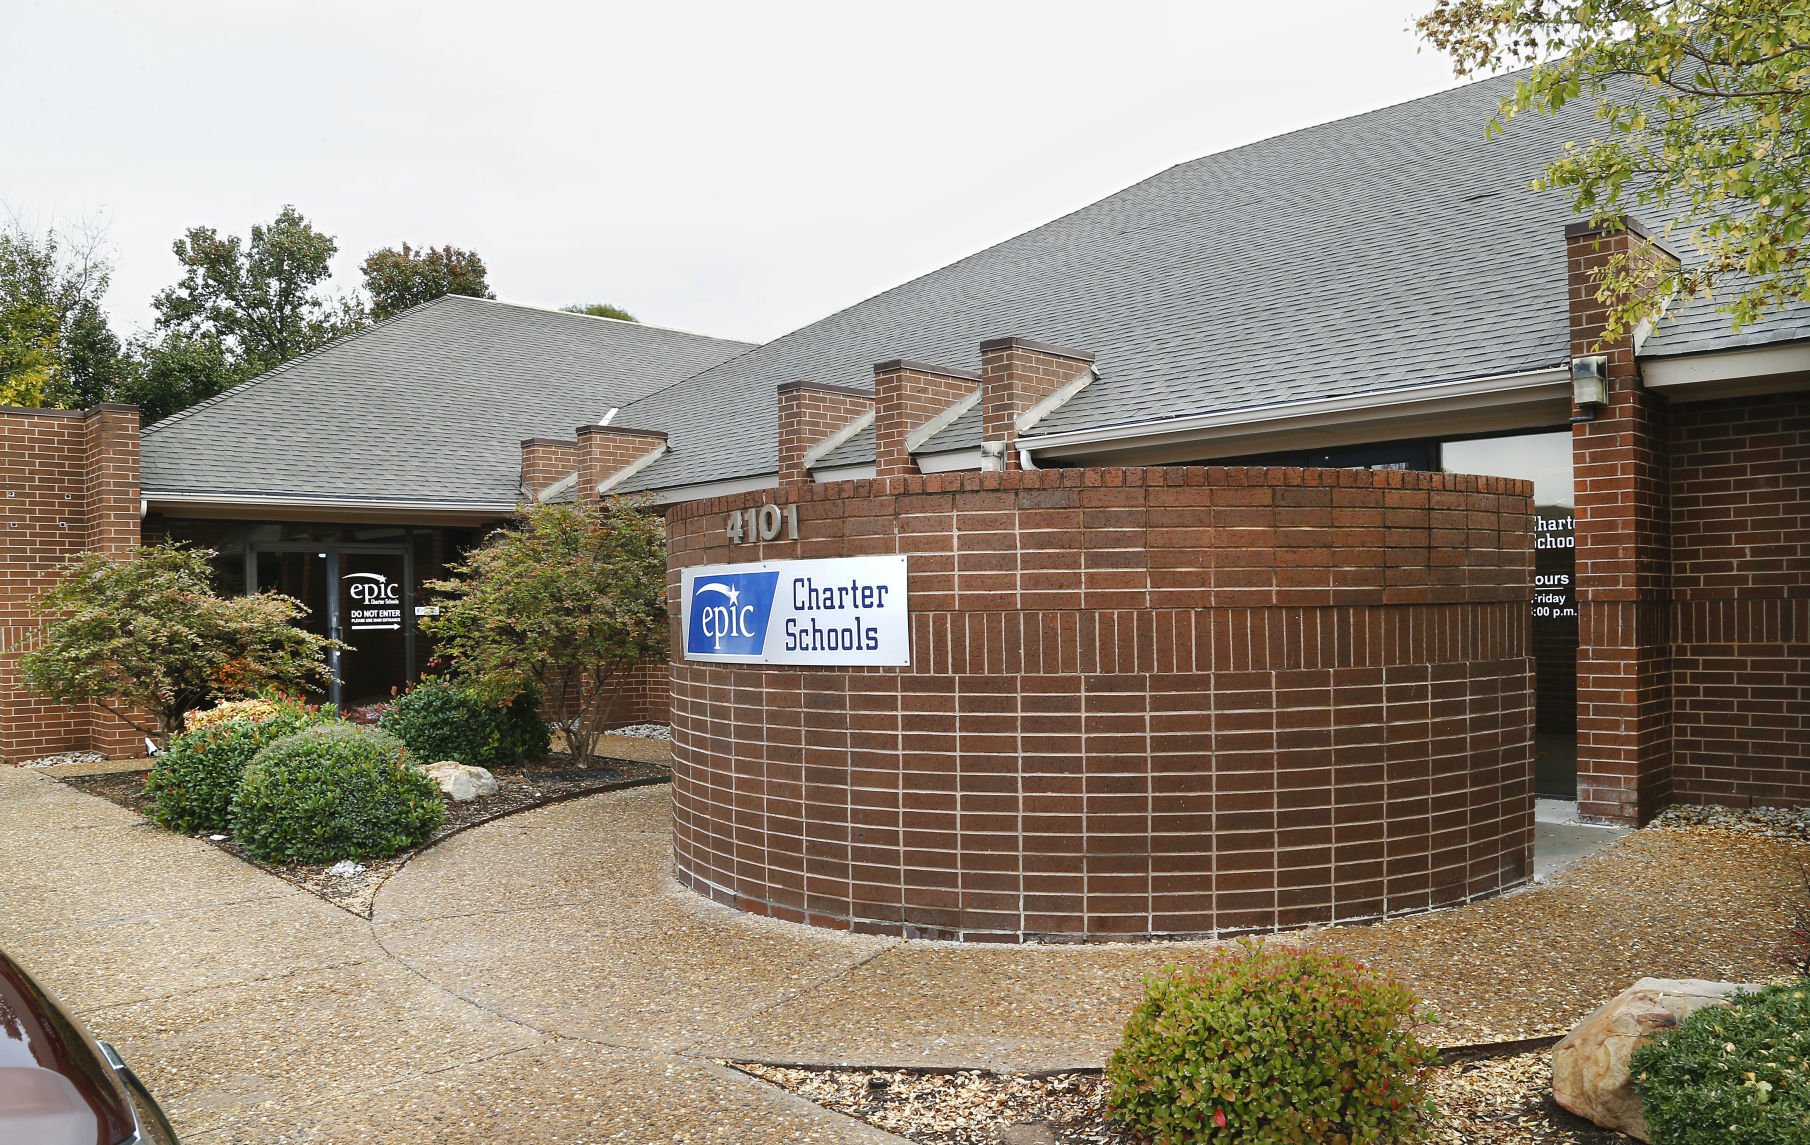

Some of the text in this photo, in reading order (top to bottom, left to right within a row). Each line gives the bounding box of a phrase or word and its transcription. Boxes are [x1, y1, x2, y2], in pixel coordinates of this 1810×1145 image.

[726, 503, 799, 544] 4101
[1534, 515, 1576, 531] hart
[1534, 532, 1575, 549] choo
[350, 583, 399, 605] epic
[793, 577, 889, 611] Charter
[351, 610, 362, 618] DO
[379, 609, 400, 618] ENTER
[1553, 607, 1578, 619] p.m.
[702, 601, 755, 650] epic
[785, 616, 879, 651] Schools
